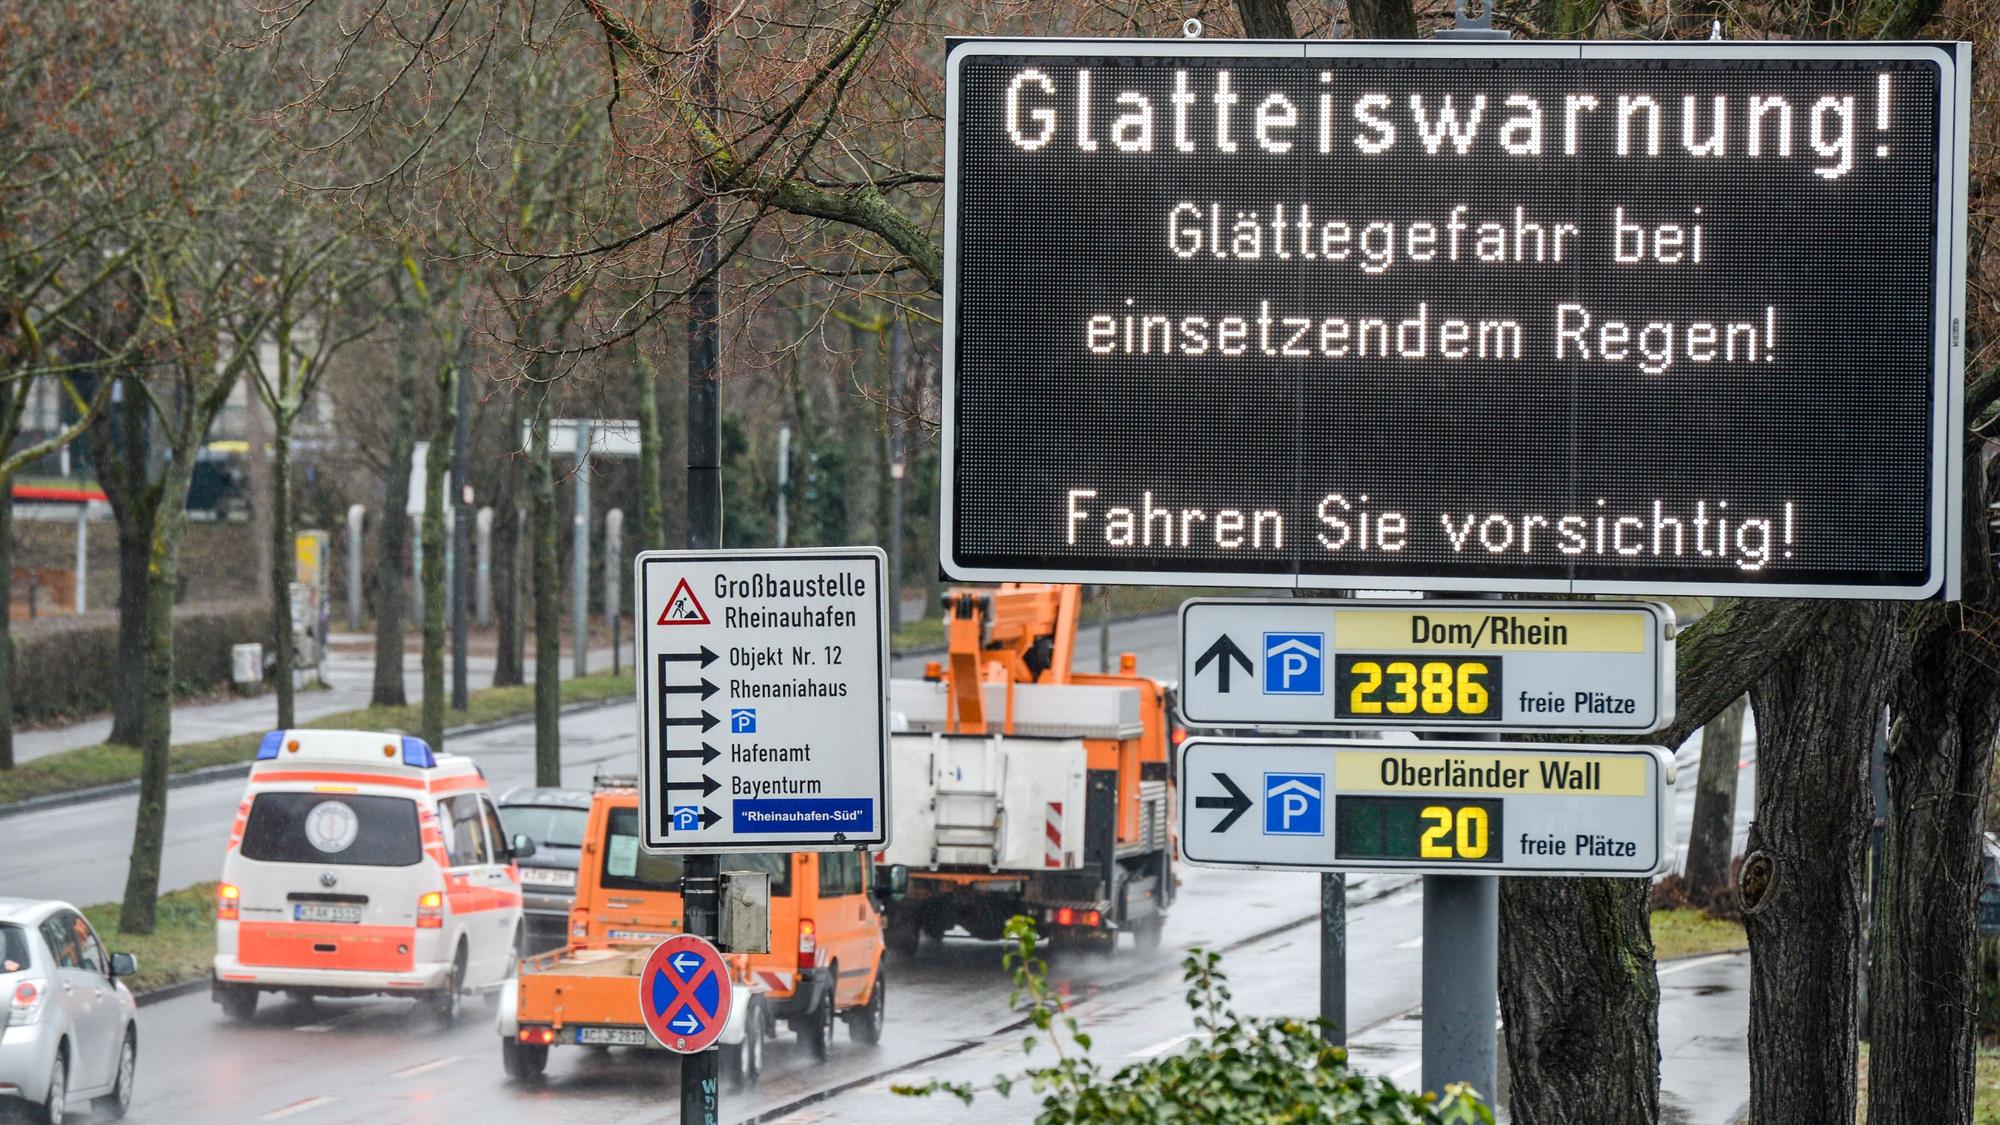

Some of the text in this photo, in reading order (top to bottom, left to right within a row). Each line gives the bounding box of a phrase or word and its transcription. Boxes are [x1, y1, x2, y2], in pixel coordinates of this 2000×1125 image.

[1005, 68, 1892, 179] Glatteiswarnung!
[1169, 202, 1701, 274] Glättegefahr bei
[1087, 299, 1774, 374] einsetzendem Regen!
[1068, 489, 1793, 571] Fahren Sie vorsichtig!
[715, 573, 865, 598] Großbaustelle
[726, 606, 855, 628] Rheinauhafen
[1413, 616, 1567, 648] Dom/Rhein
[730, 646, 841, 670] Objekt Nr. 12
[1282, 654, 1308, 689] P
[731, 679, 846, 698] Rhenaniahaus
[1351, 663, 1488, 713] 2386
[1520, 691, 1635, 713] freie Plätze
[732, 744, 810, 762] Hafenamt
[733, 776, 820, 798] Bayenturm
[1382, 758, 1599, 789] Oberländer Wall
[741, 810, 863, 822] “Rheinauhafen-Süd”
[1282, 794, 1308, 829] P
[1421, 807, 1487, 858] 20
[1521, 834, 1635, 856] freie Plätze
